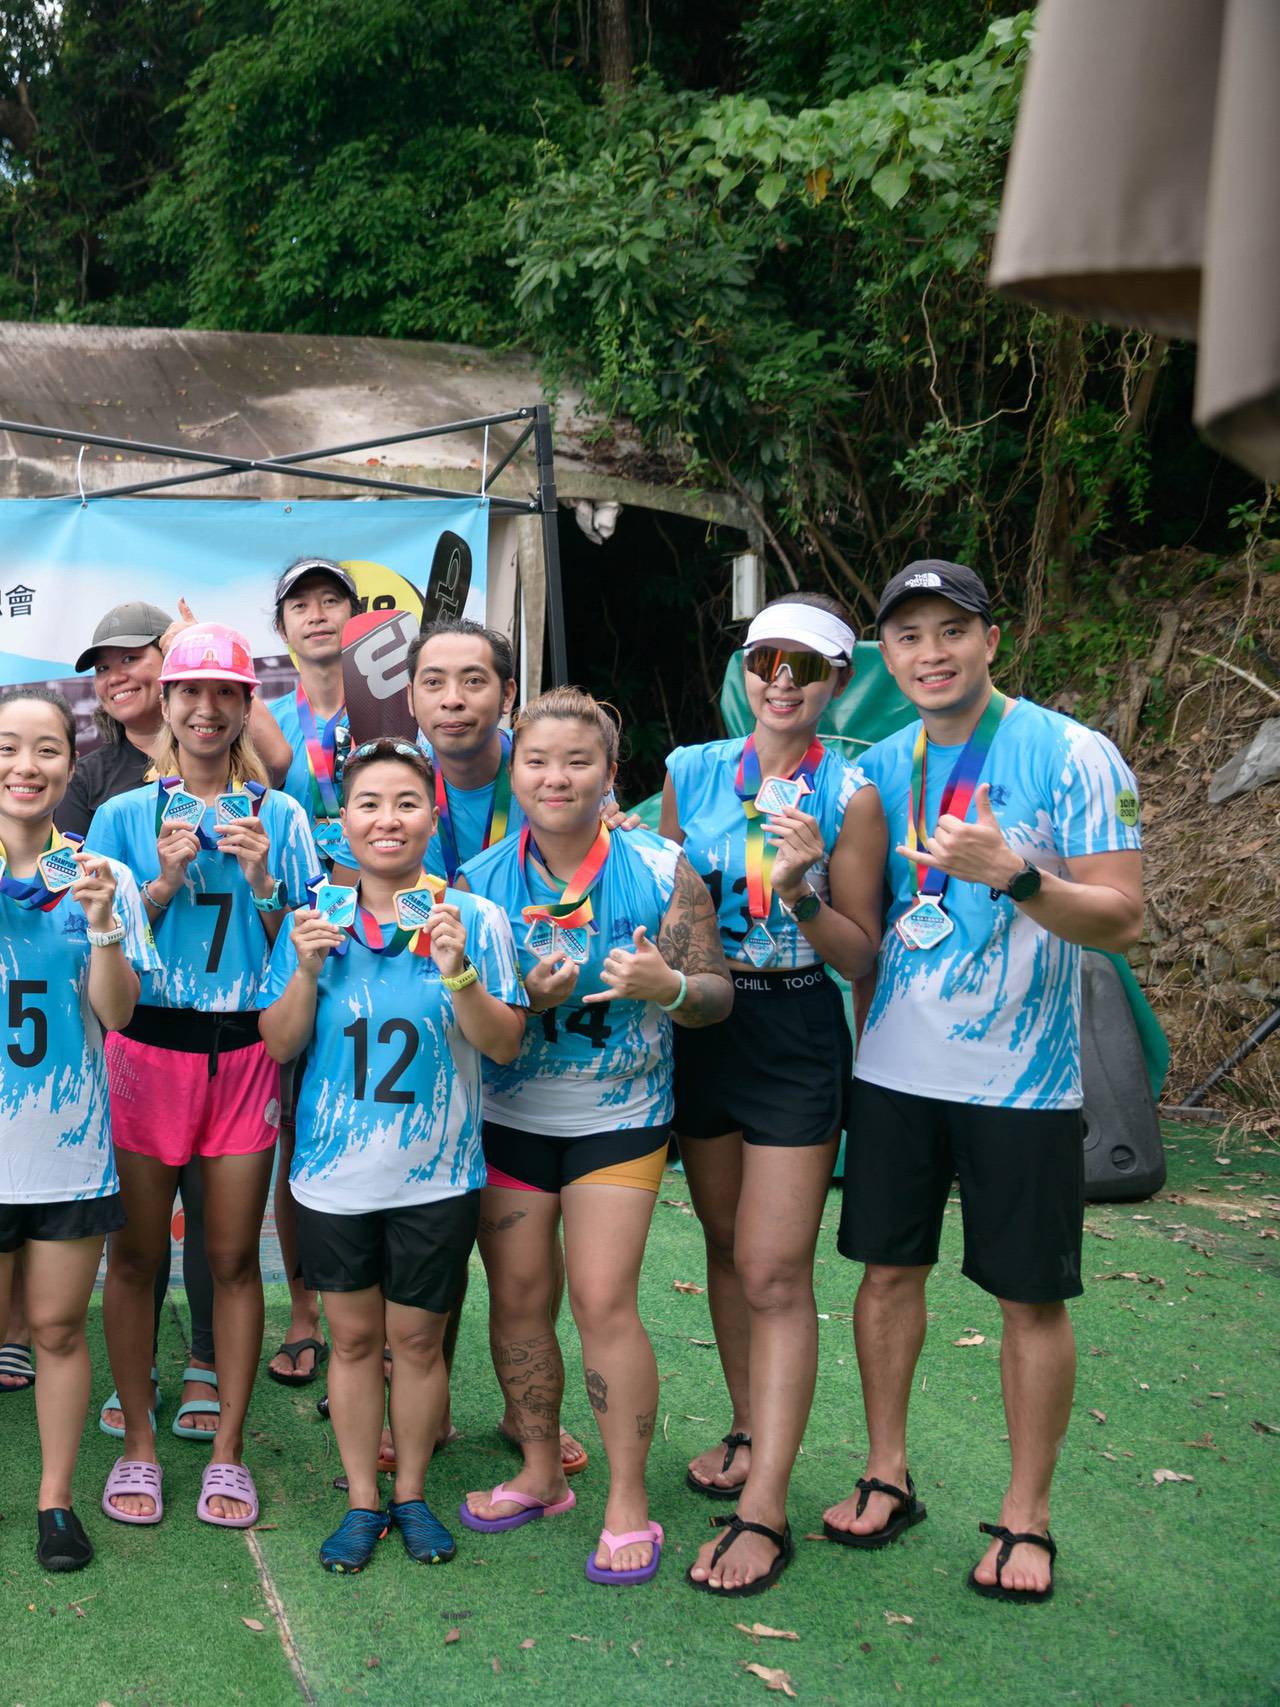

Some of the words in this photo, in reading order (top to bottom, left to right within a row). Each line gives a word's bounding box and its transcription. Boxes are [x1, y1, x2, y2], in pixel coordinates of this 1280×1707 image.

[196, 893, 233, 973] 7
[7, 980, 48, 1068] 5
[542, 1000, 612, 1048] 14
[735, 977, 771, 991] CHILL
[344, 1018, 420, 1104] 12
